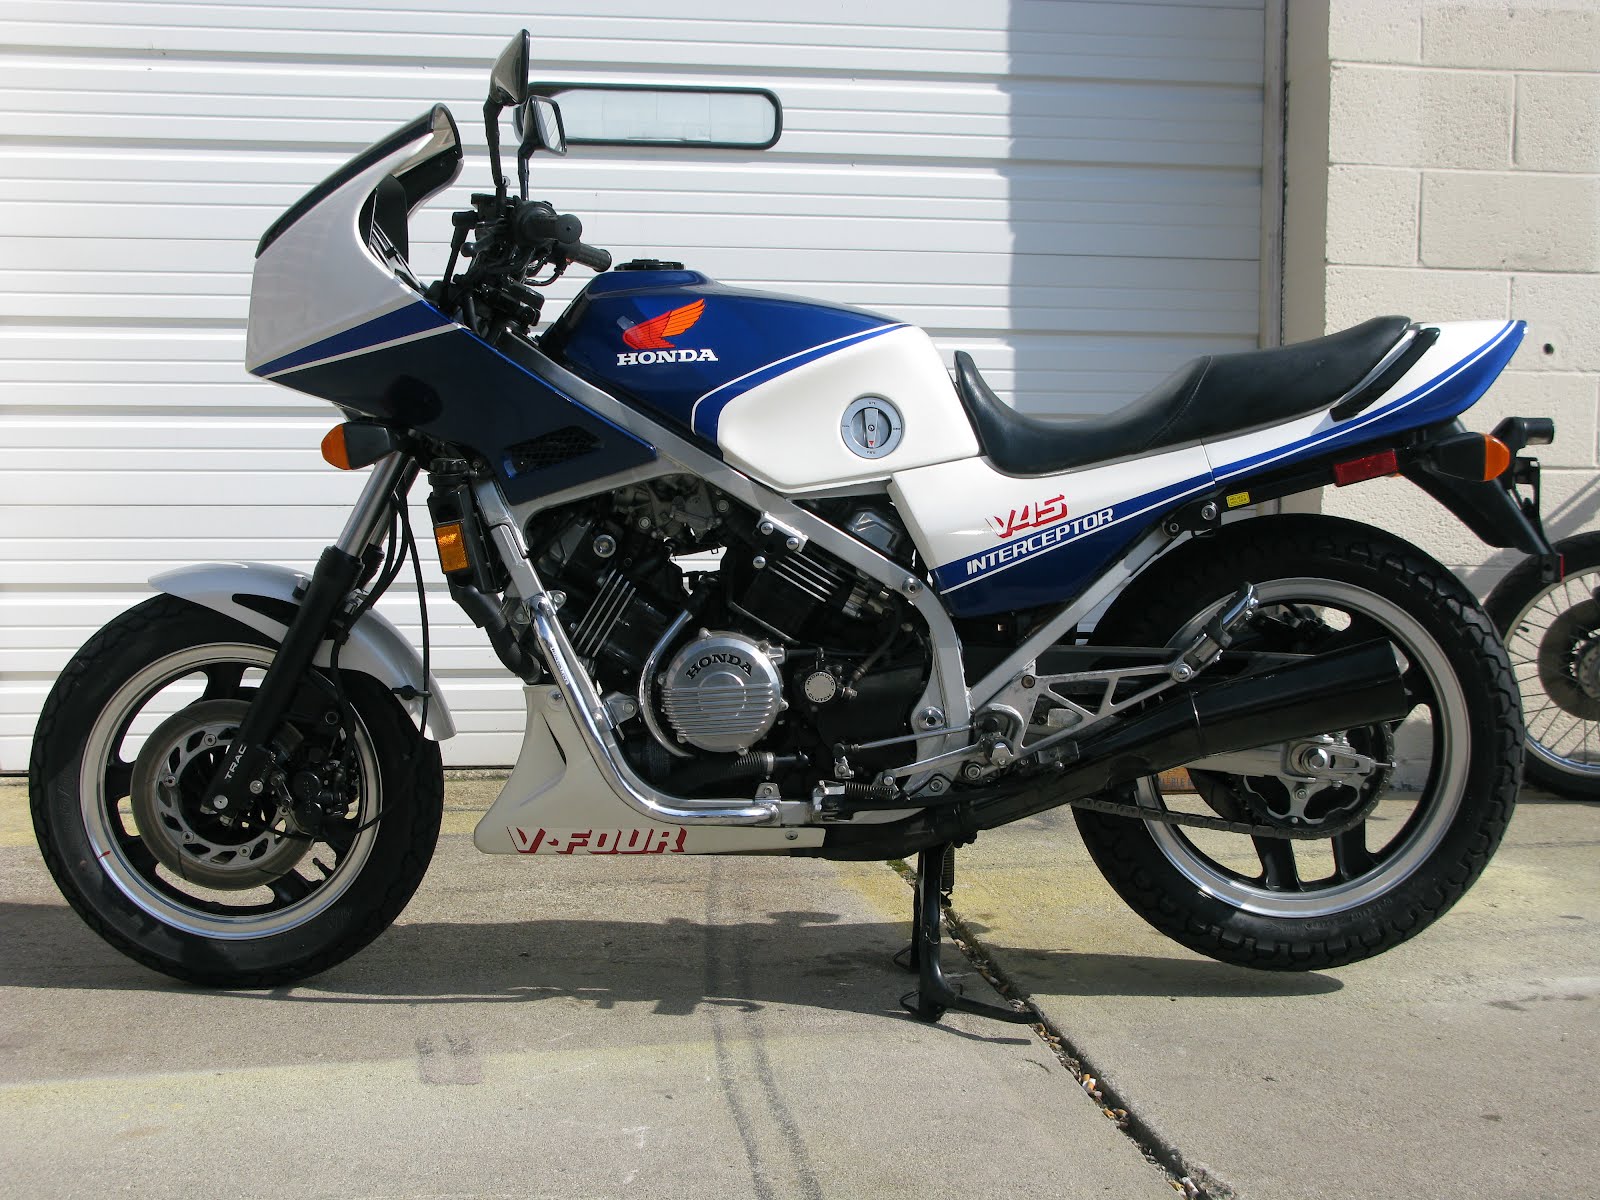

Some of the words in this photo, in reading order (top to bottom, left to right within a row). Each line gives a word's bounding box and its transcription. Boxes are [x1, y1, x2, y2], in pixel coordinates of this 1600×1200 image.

[617, 349, 718, 366] HONDA
[985, 494, 1068, 539] V45
[966, 508, 1114, 576] INTERCEPTOR
[685, 653, 753, 679] HONDA
[807, 672, 835, 686] HYDRAULIC
[808, 693, 832, 702] CLUTCH
[224, 743, 247, 780] TRAC
